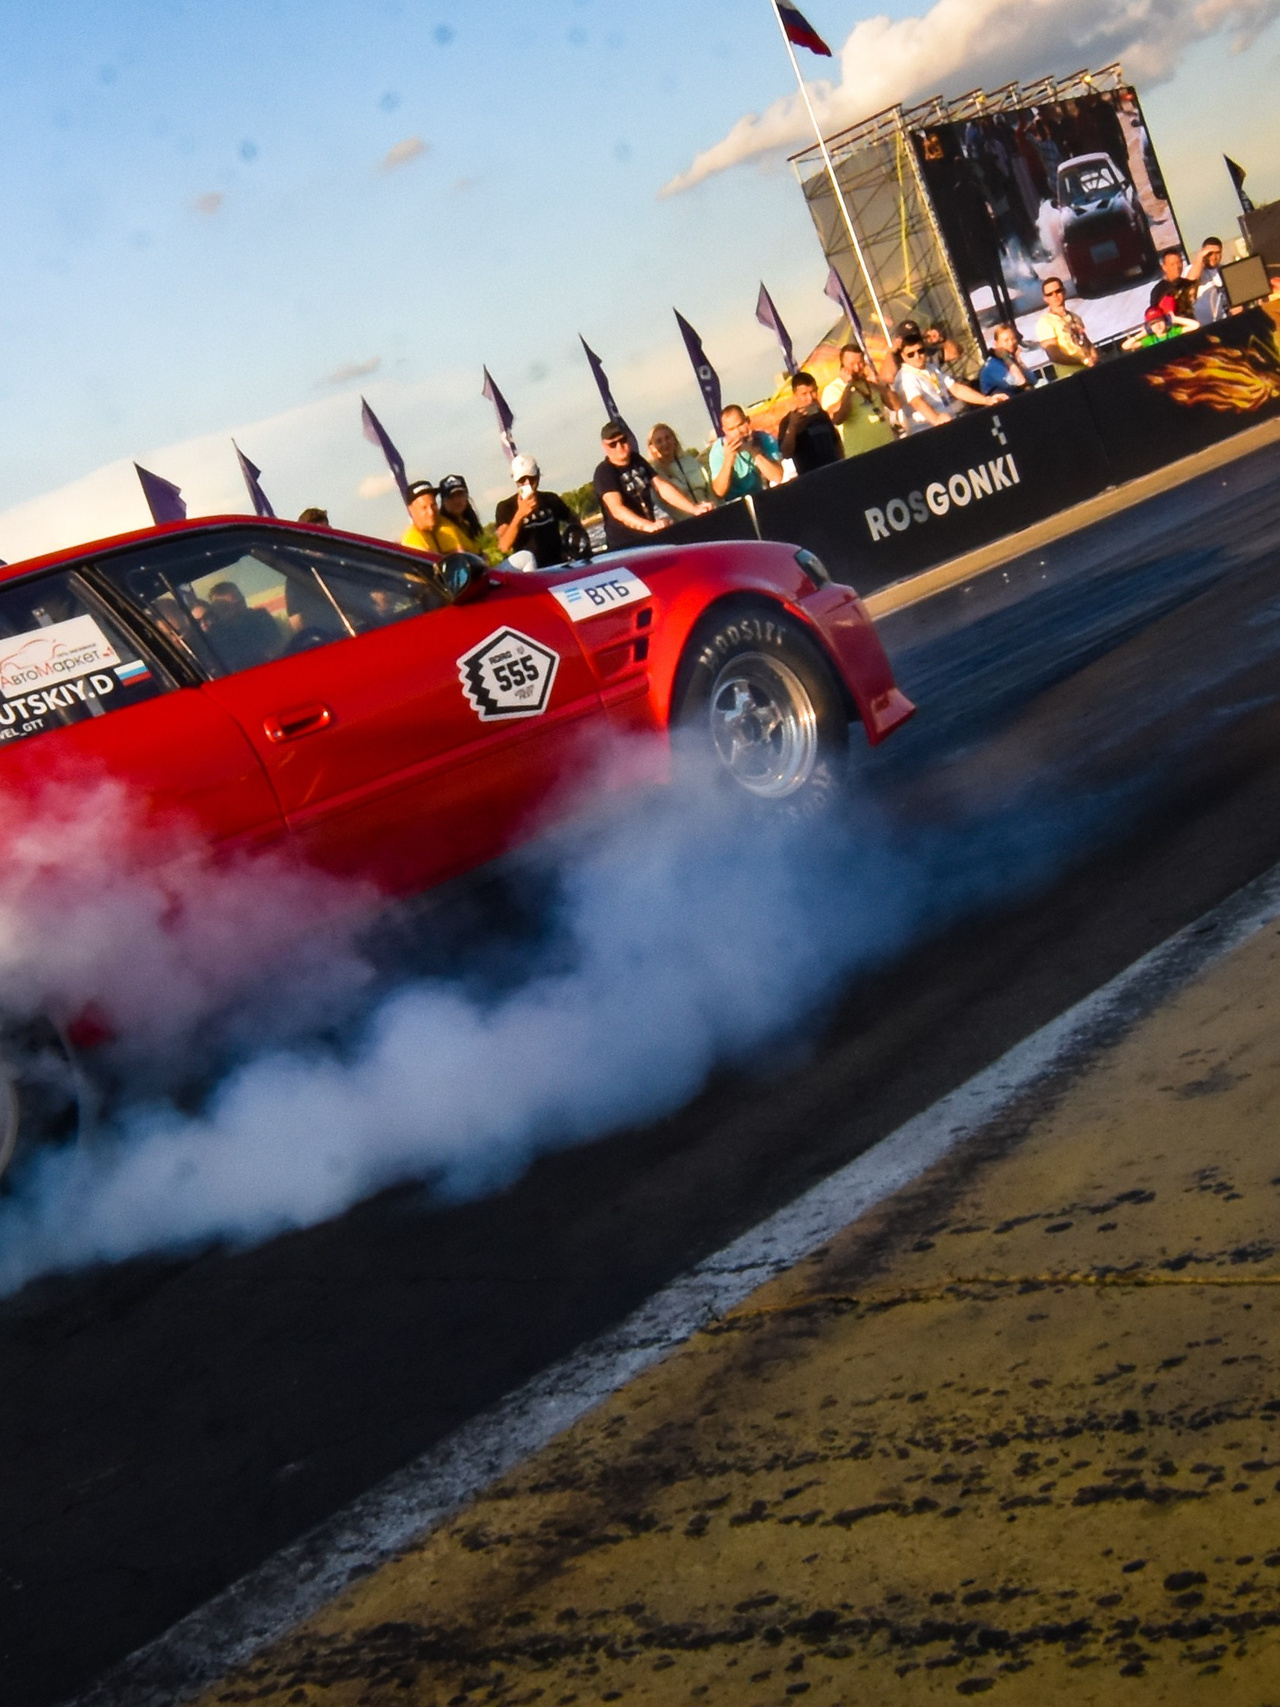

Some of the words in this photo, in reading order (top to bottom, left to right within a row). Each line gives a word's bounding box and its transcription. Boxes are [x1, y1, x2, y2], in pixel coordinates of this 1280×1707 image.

[864, 453, 1020, 541] ROSGONKI
[584, 579, 630, 606] ВТБ
[493, 654, 539, 692] 555
